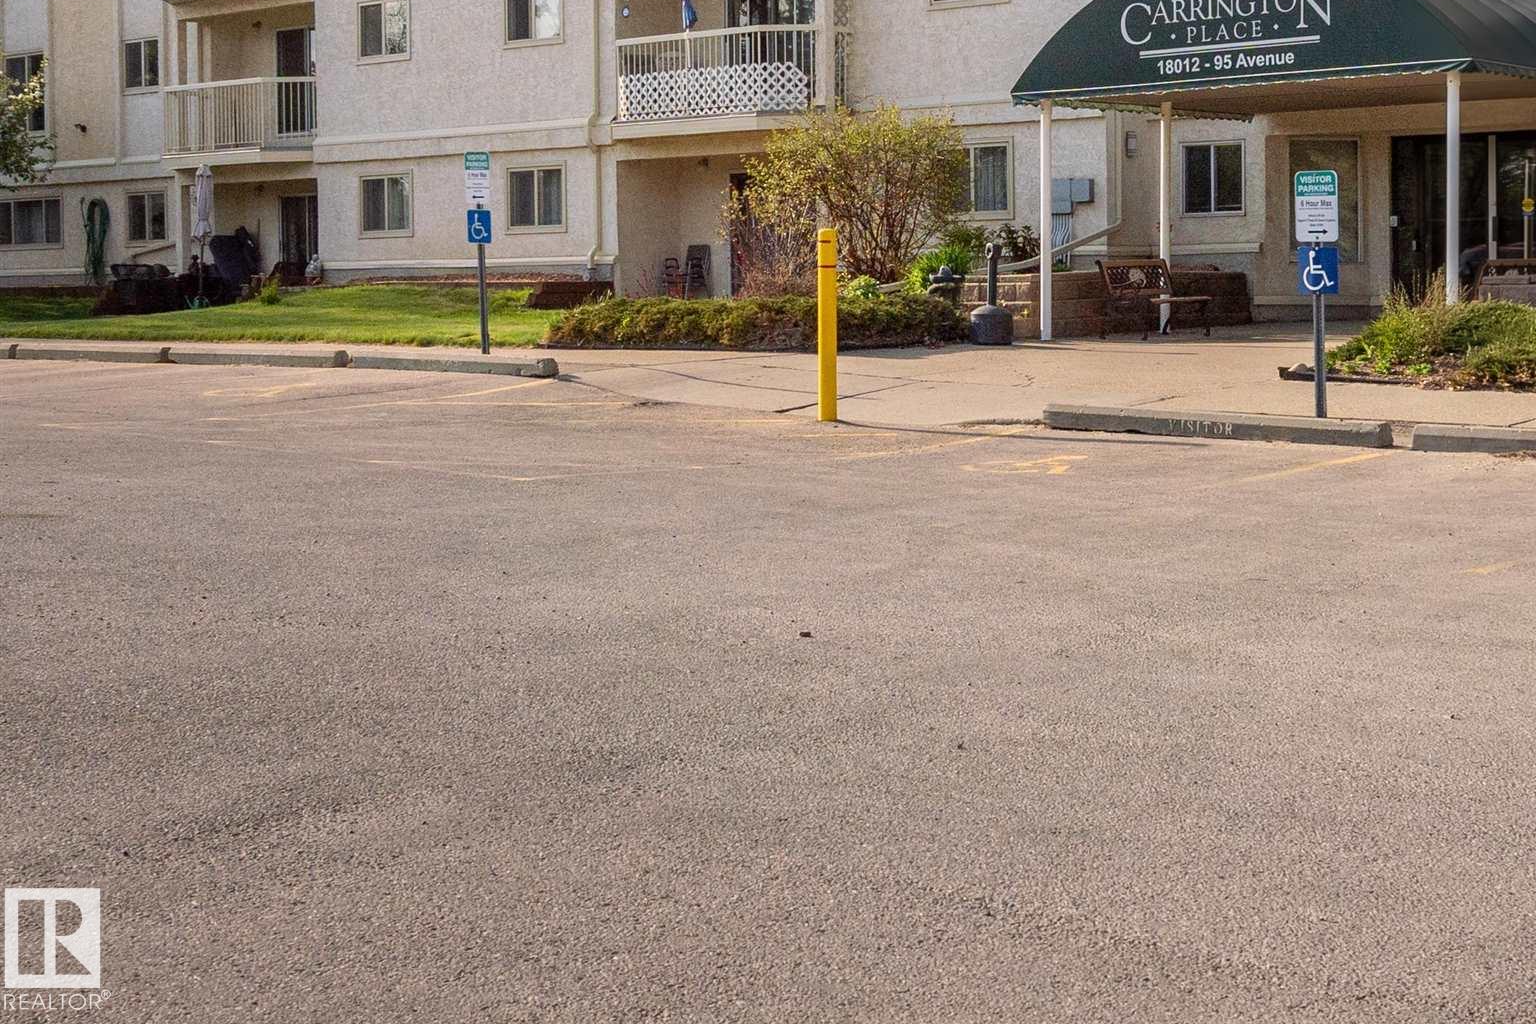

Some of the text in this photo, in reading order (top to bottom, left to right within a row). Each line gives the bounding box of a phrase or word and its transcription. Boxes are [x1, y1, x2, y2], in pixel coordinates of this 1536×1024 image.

[1186, 20, 1263, 43] PLACE
[1157, 57, 1200, 75] 18012
[1214, 55, 1232, 69] 95
[1236, 52, 1295, 68] Avenue
[1299, 175, 1332, 184] VISITOR
[1297, 184, 1334, 193] PARKING
[1168, 419, 1233, 436] VISITOR
